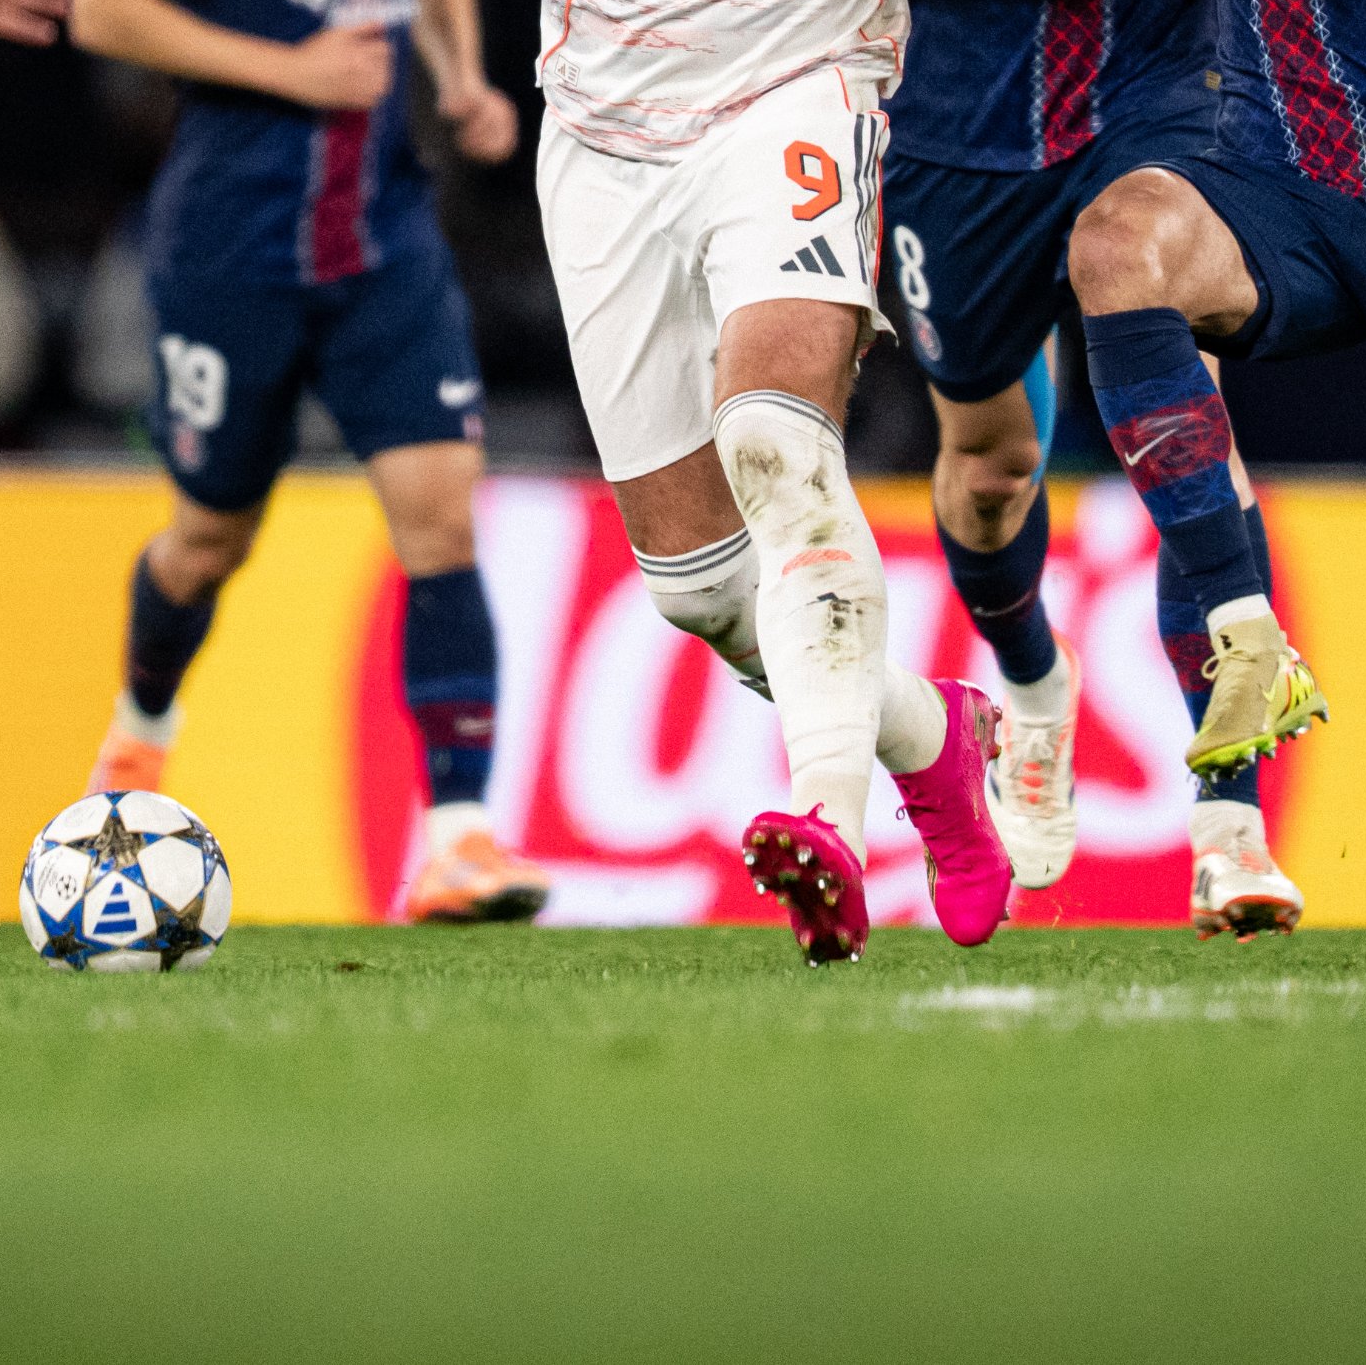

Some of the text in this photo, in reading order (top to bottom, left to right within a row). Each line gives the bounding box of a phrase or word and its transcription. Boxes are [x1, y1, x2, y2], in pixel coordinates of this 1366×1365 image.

[783, 140, 842, 221] 9
[894, 225, 931, 310] 8
[159, 335, 230, 433] 19
